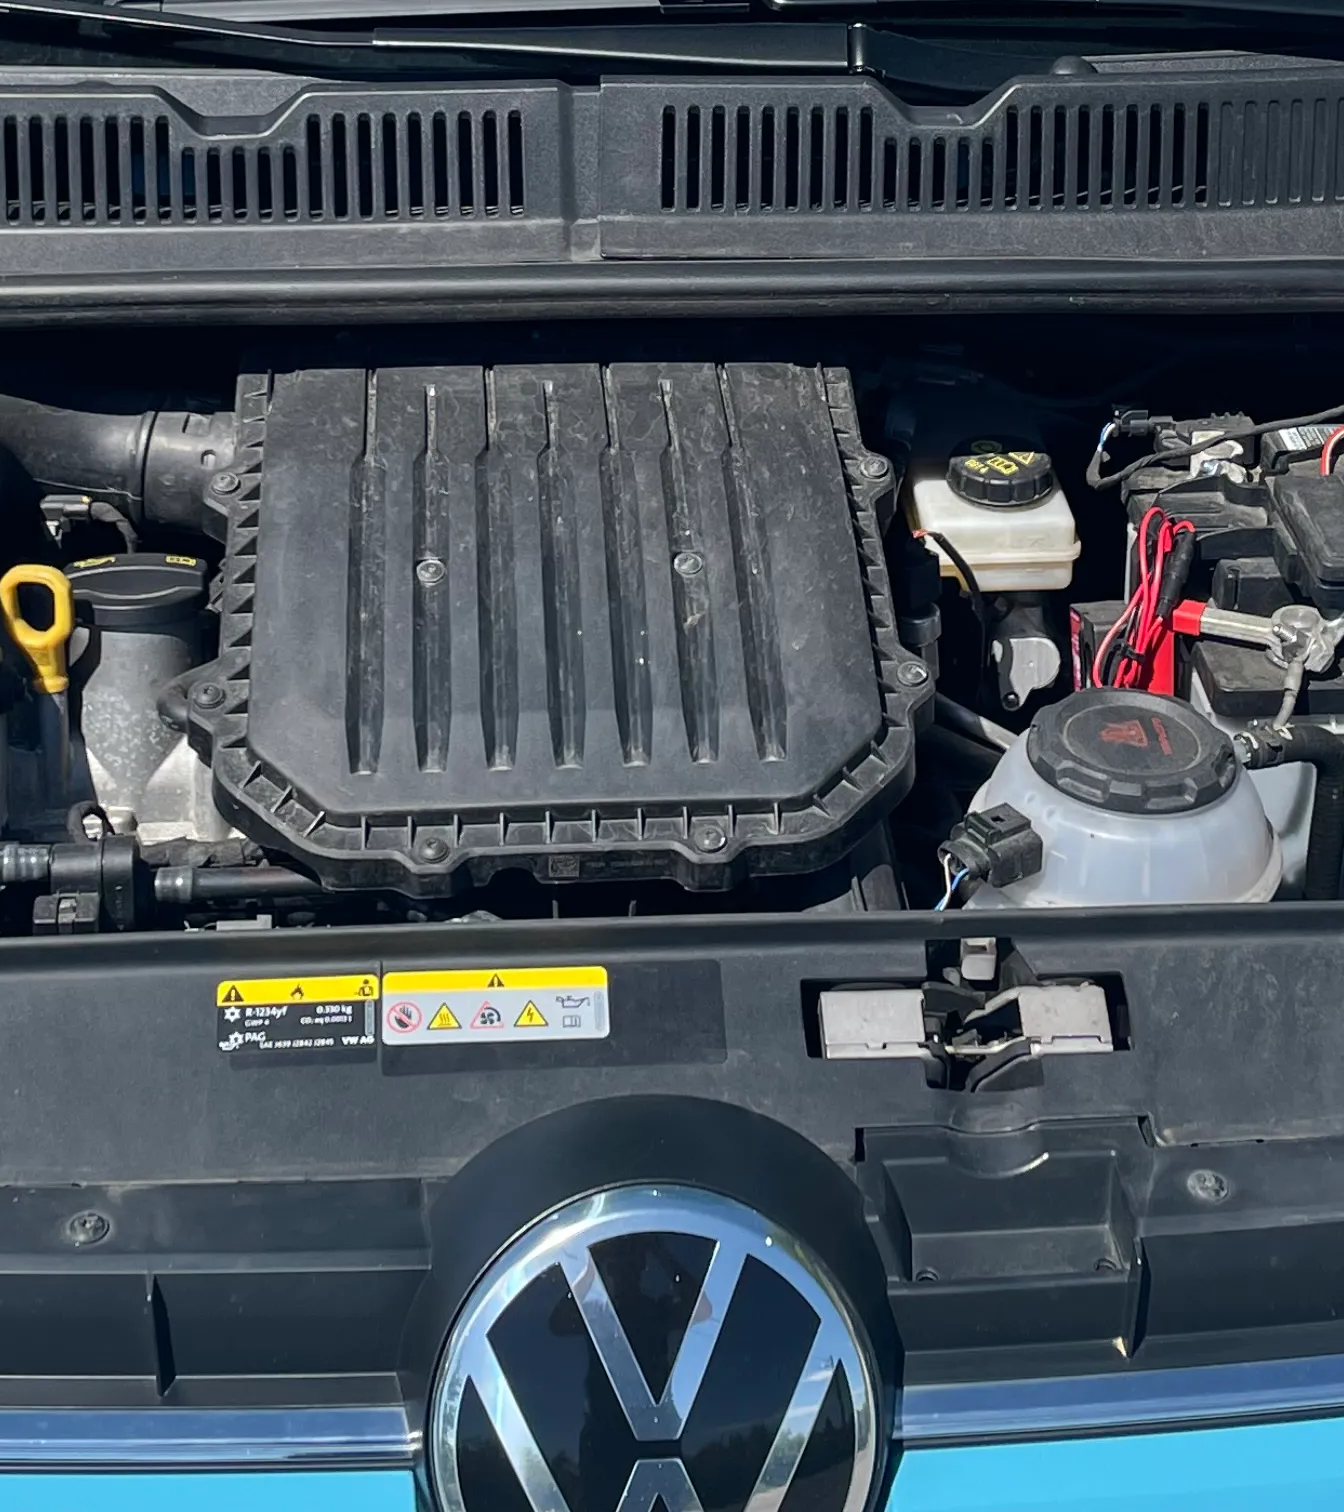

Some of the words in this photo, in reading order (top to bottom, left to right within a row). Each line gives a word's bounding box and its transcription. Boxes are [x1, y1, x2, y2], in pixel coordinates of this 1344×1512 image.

[245, 1031, 266, 1043] PAG
[341, 1035, 359, 1046] VW
[359, 1035, 375, 1045] AG
